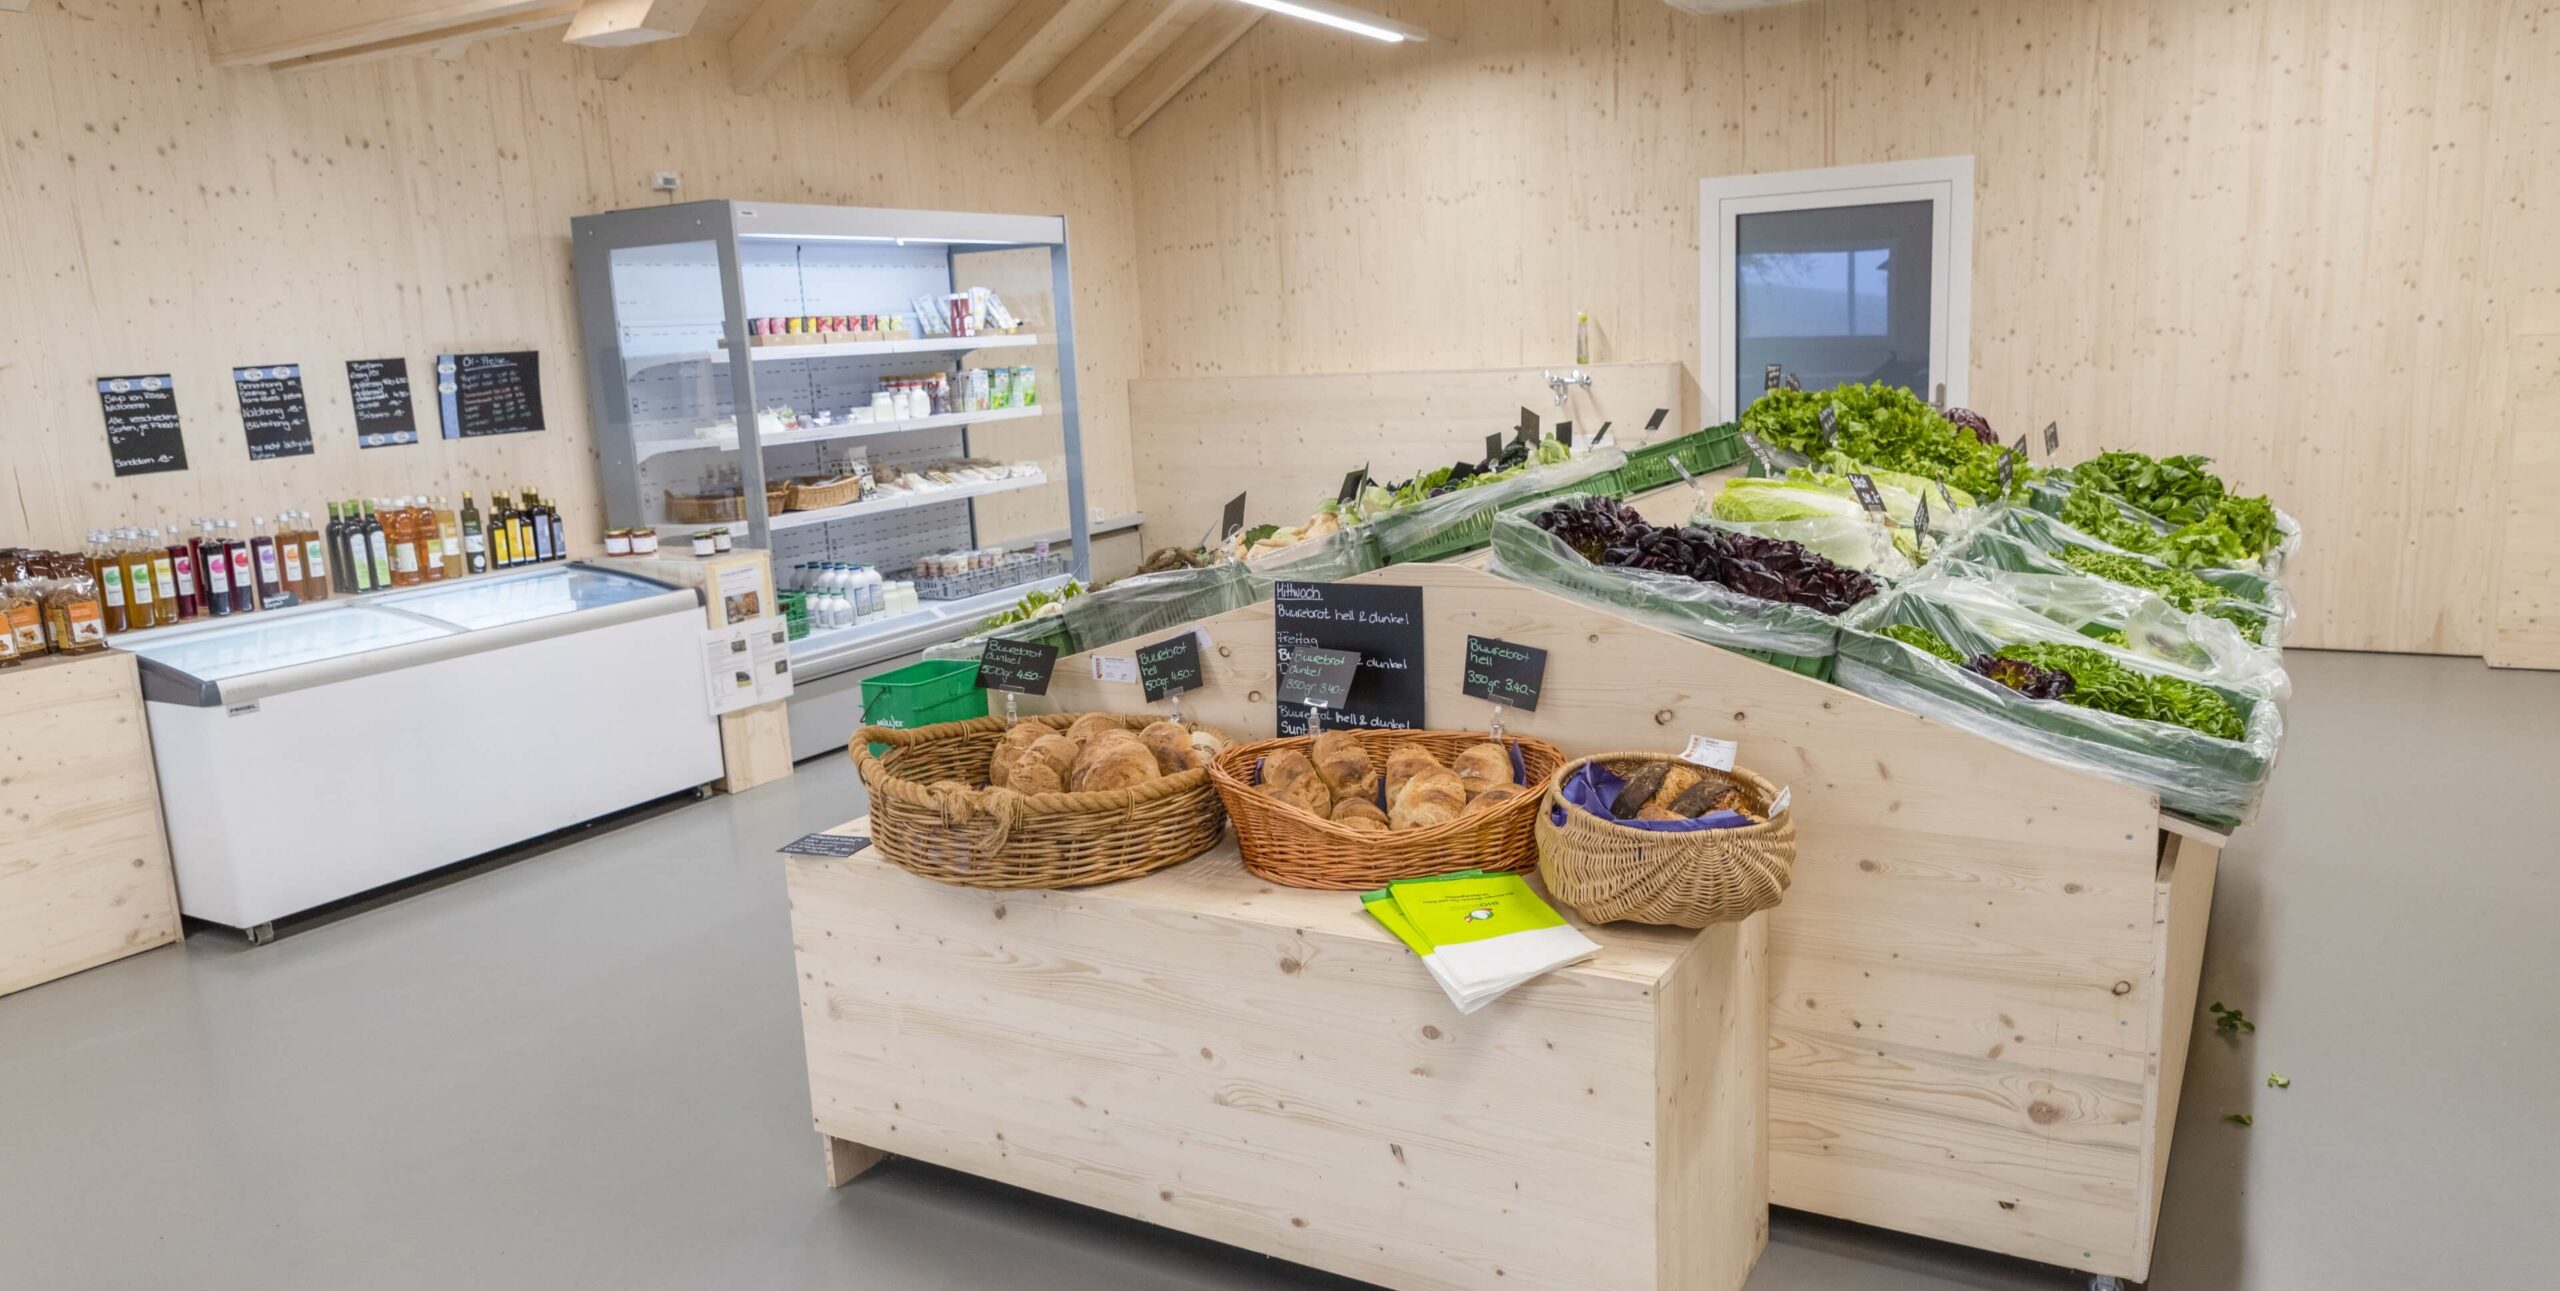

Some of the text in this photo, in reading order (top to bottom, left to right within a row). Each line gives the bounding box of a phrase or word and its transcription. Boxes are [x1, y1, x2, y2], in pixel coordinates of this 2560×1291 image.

[1277, 582, 1322, 600] Mittwoch
[1277, 603, 1409, 625] Buurebrot hell & dunkel
[1277, 631, 1319, 648] Freitag
[989, 640, 1043, 657] Buurebrot
[1140, 642, 1187, 665] Buurebrot
[1468, 638, 1530, 661] Buurebrot
[985, 651, 1022, 665] dunkel
[1366, 657, 1407, 669] dunkel
[1470, 652, 1493, 667] hell
[1142, 666, 1157, 676] hell
[1289, 665, 1321, 677] dunkel
[1336, 711, 1356, 725] hell
